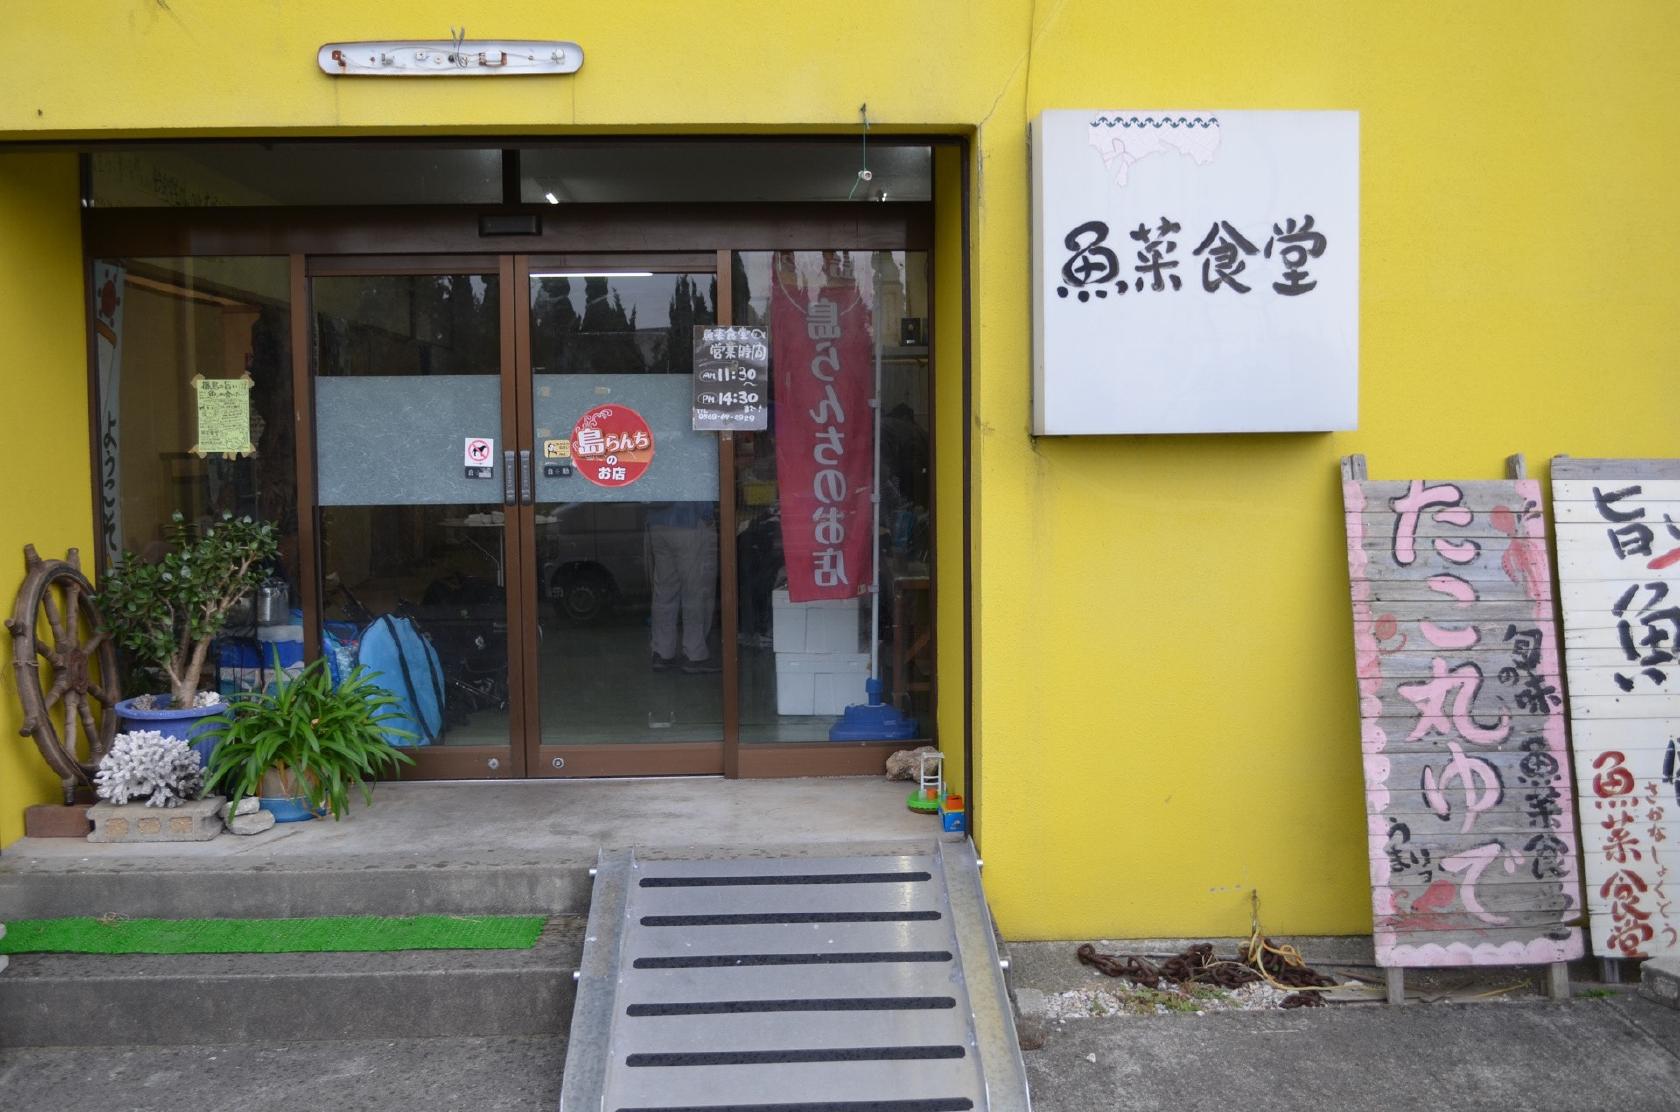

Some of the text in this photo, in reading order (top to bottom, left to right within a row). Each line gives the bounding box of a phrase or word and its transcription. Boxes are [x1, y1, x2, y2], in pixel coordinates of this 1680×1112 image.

[1056, 214, 1328, 303] 魚菜食堂
[710, 342, 767, 361] 営業時間
[717, 366, 757, 382] 11:30
[702, 391, 759, 406] PM 14:30
[578, 428, 650, 456] 島らんち
[606, 455, 618, 466] の
[598, 466, 626, 481] お店
[1387, 480, 1525, 927] たこ丸ゆで
[1592, 750, 1654, 958] 魚菜食堂
